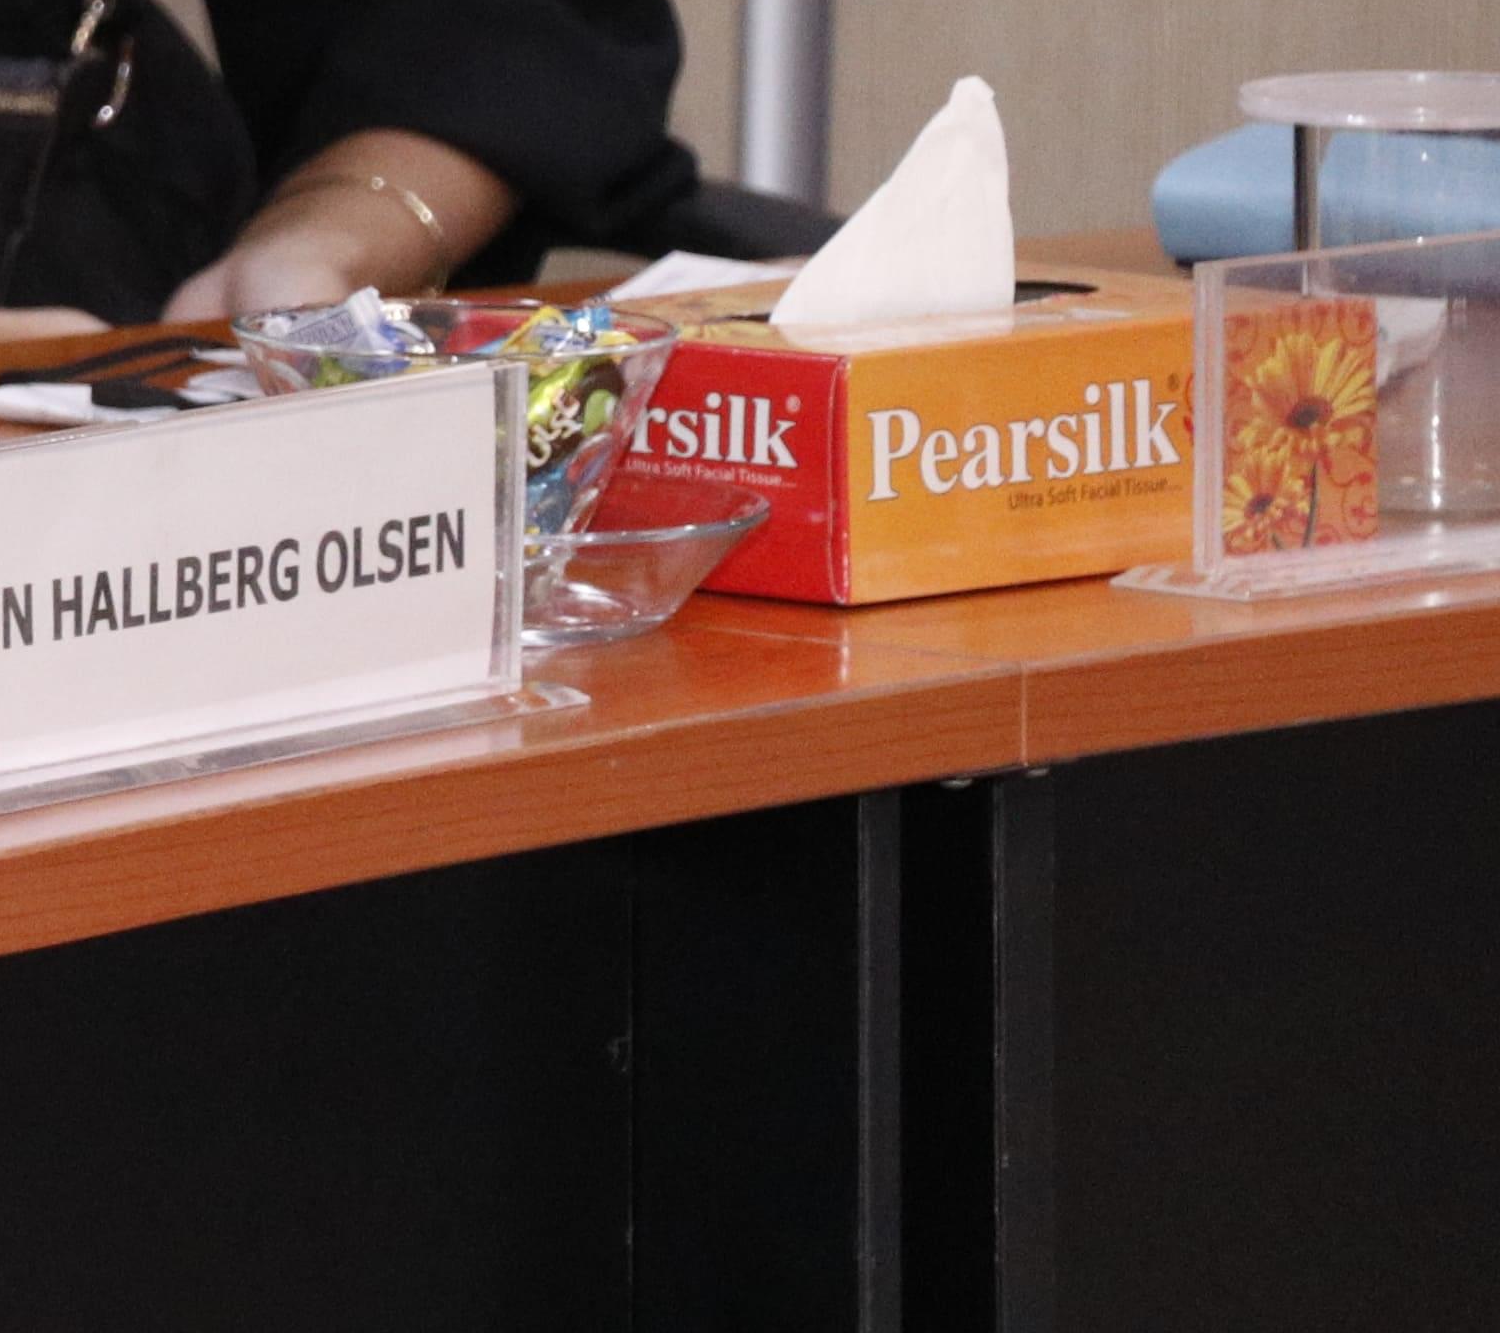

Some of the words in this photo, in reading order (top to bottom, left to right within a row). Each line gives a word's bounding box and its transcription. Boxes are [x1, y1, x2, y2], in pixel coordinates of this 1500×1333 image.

[629, 391, 799, 469] rsilk
[664, 460, 692, 478] Soft
[867, 379, 1180, 501] Pearsilk
[1009, 490, 1044, 509] Ultra
[1047, 484, 1077, 506] Soft
[1080, 478, 1121, 500] Facial
[51, 537, 301, 641] HALLBERG
[315, 507, 467, 594] OLSEN
